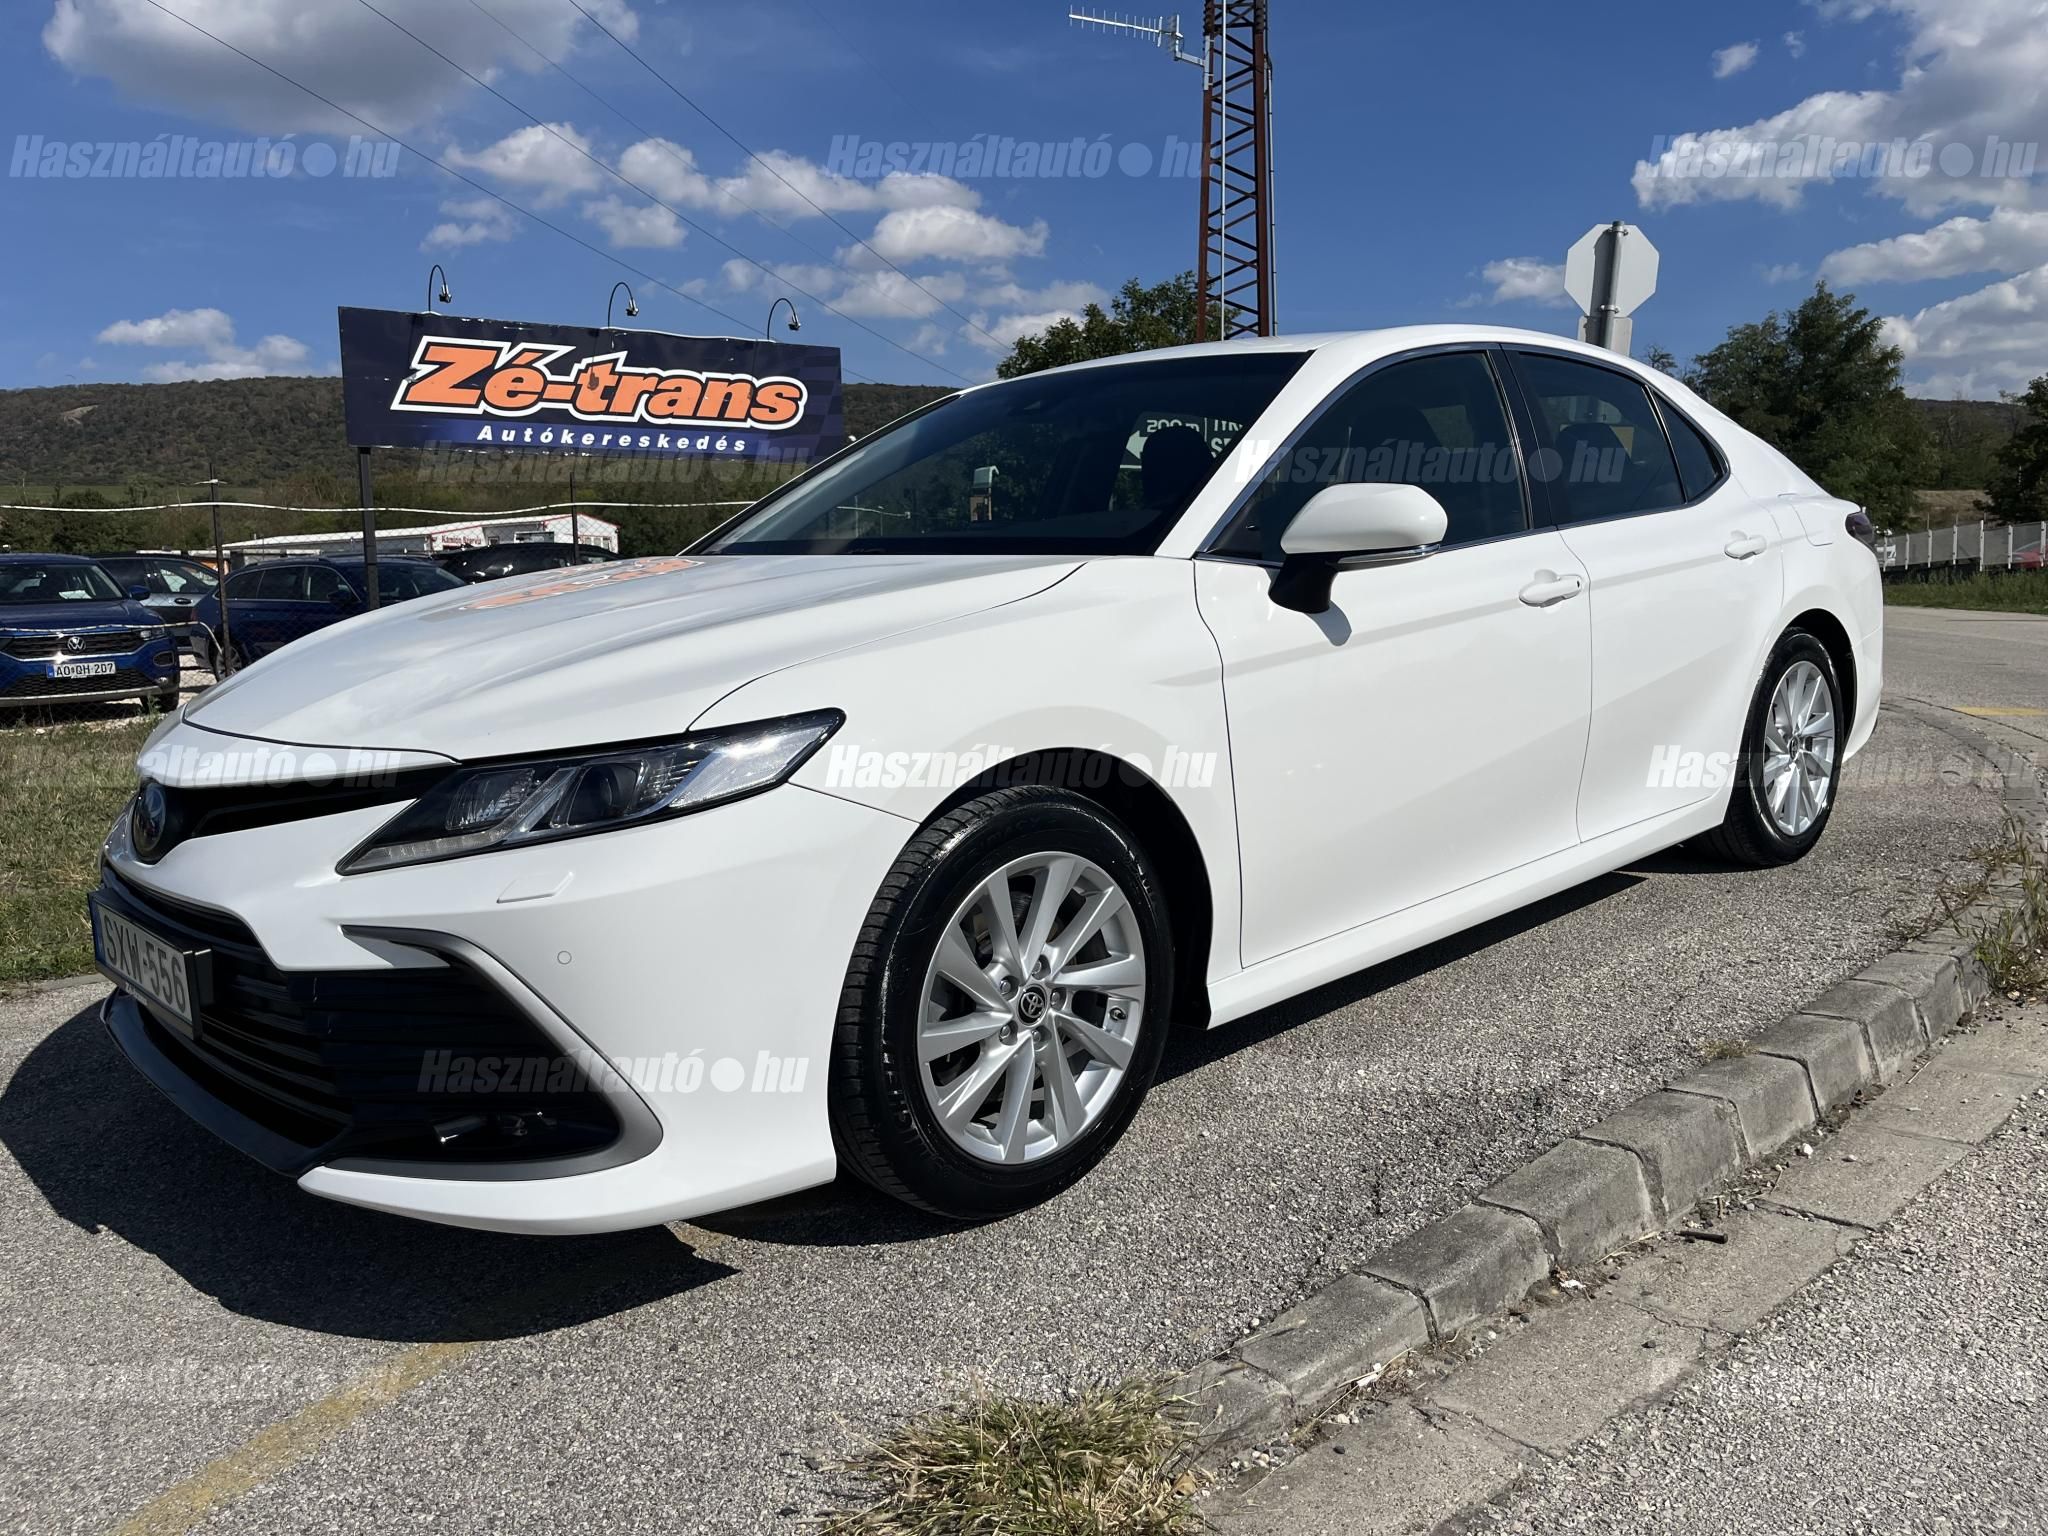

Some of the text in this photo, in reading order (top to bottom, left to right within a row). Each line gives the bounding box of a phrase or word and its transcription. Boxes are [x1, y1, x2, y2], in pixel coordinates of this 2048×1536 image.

[395, 337, 806, 428] Zé-trans
[477, 425, 746, 452] Autókereskedés
[103, 914, 186, 1014] SXW-556
